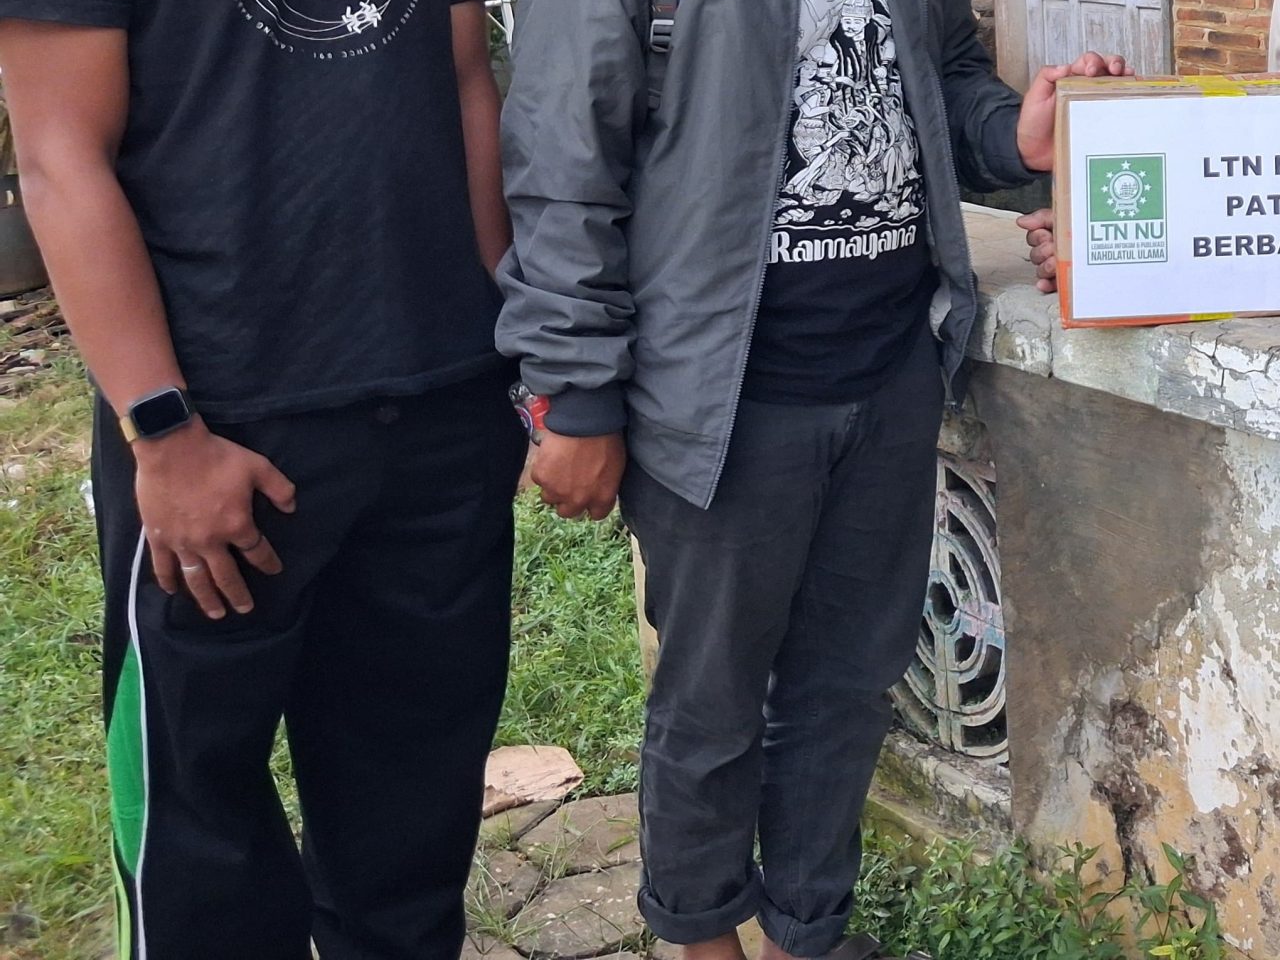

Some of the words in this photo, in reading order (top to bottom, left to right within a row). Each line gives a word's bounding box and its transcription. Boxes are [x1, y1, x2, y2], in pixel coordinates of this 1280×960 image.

[1203, 155, 1262, 178] LTN
[1090, 222, 1128, 241] LTN
[1135, 221, 1165, 240] NU
[768, 224, 917, 264] Ramayana
[1090, 249, 1136, 261] NAHDLATUL
[1137, 248, 1165, 259] ULAMA
